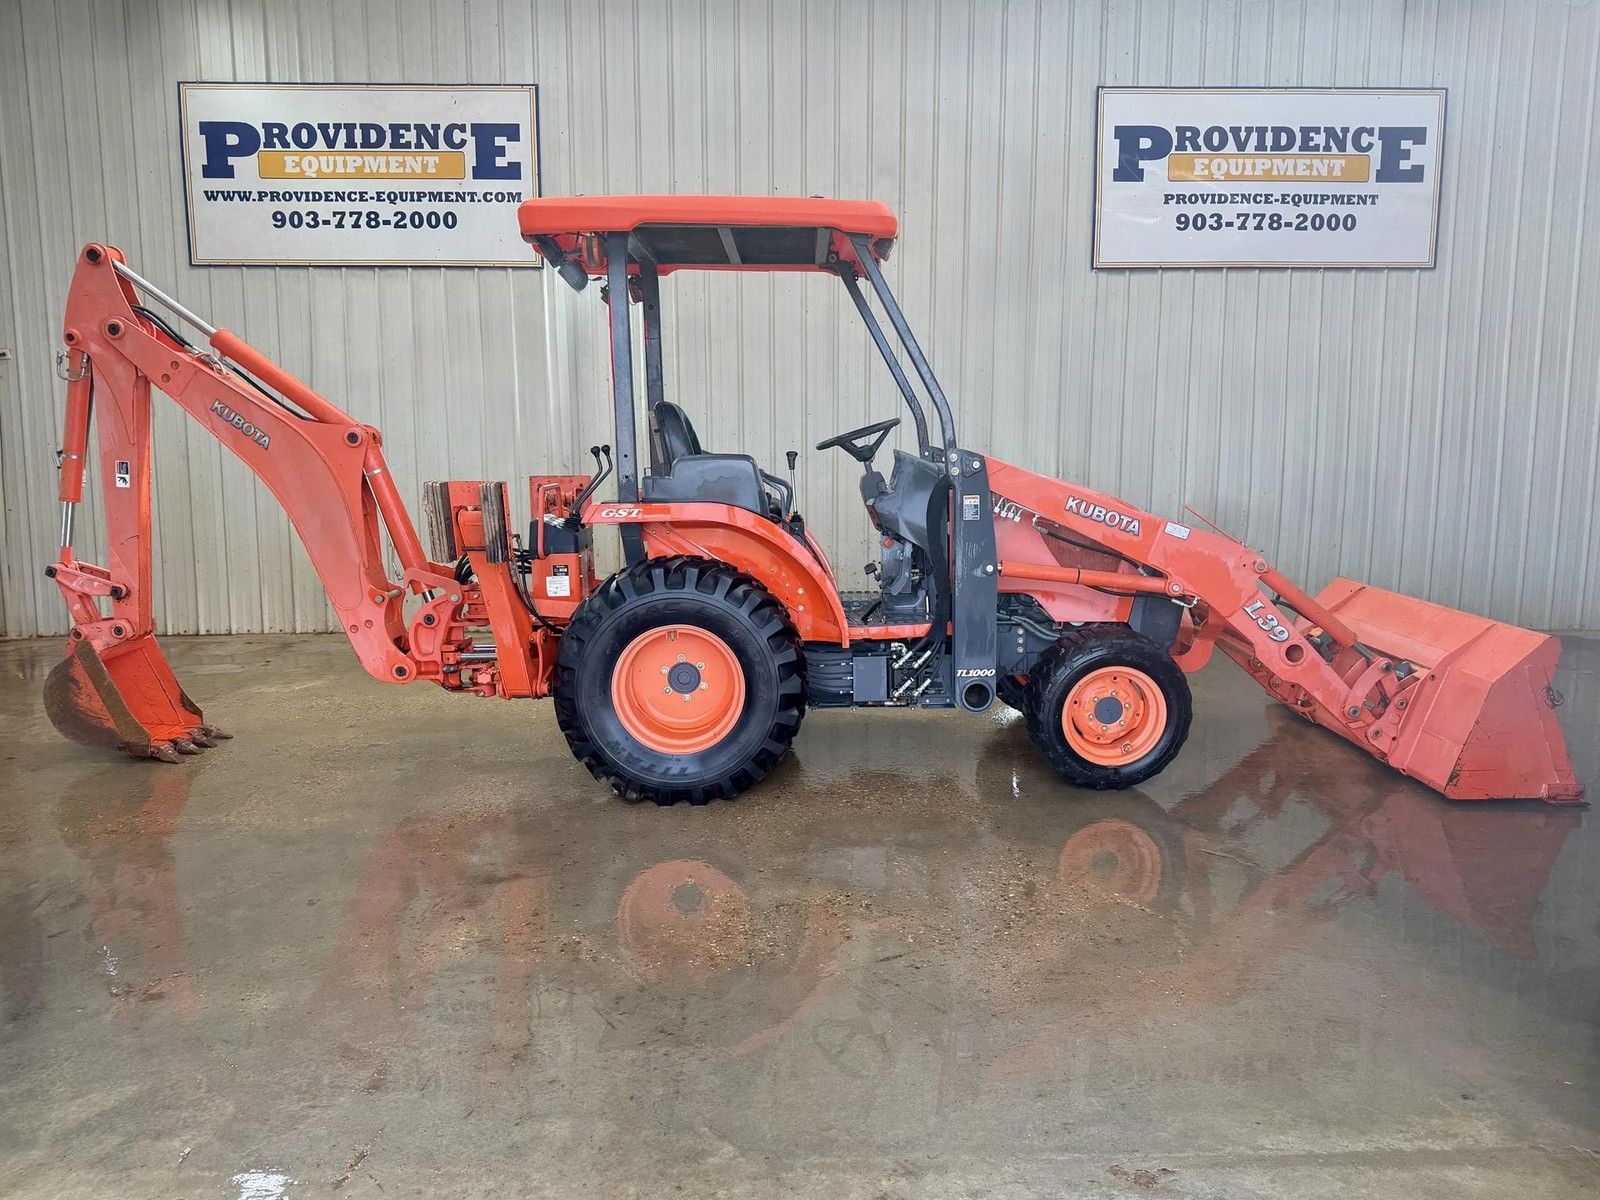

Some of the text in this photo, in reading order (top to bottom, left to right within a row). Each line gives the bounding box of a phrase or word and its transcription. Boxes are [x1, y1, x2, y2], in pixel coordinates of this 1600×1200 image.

[199, 121, 522, 180] PROVIDENCE
[1113, 125, 1427, 183] PROVIDENCE
[284, 155, 439, 178] EQUIPMENT
[1193, 158, 1346, 180] EQUIPMENT
[204, 190, 523, 205] WWW.PROVIDENCE-EQUIPMENT.COM
[1163, 193, 1379, 207] PROVIDENCE-EQUIPMENT
[271, 211, 458, 229] 903-778-2000
[1175, 213, 1357, 231] 903-778-2000
[210, 399, 270, 450] KUBOTA
[601, 508, 643, 518] GST
[1064, 496, 1141, 536] KUBOTA
[1243, 599, 1289, 642] L39
[956, 668, 996, 677] TL1000
